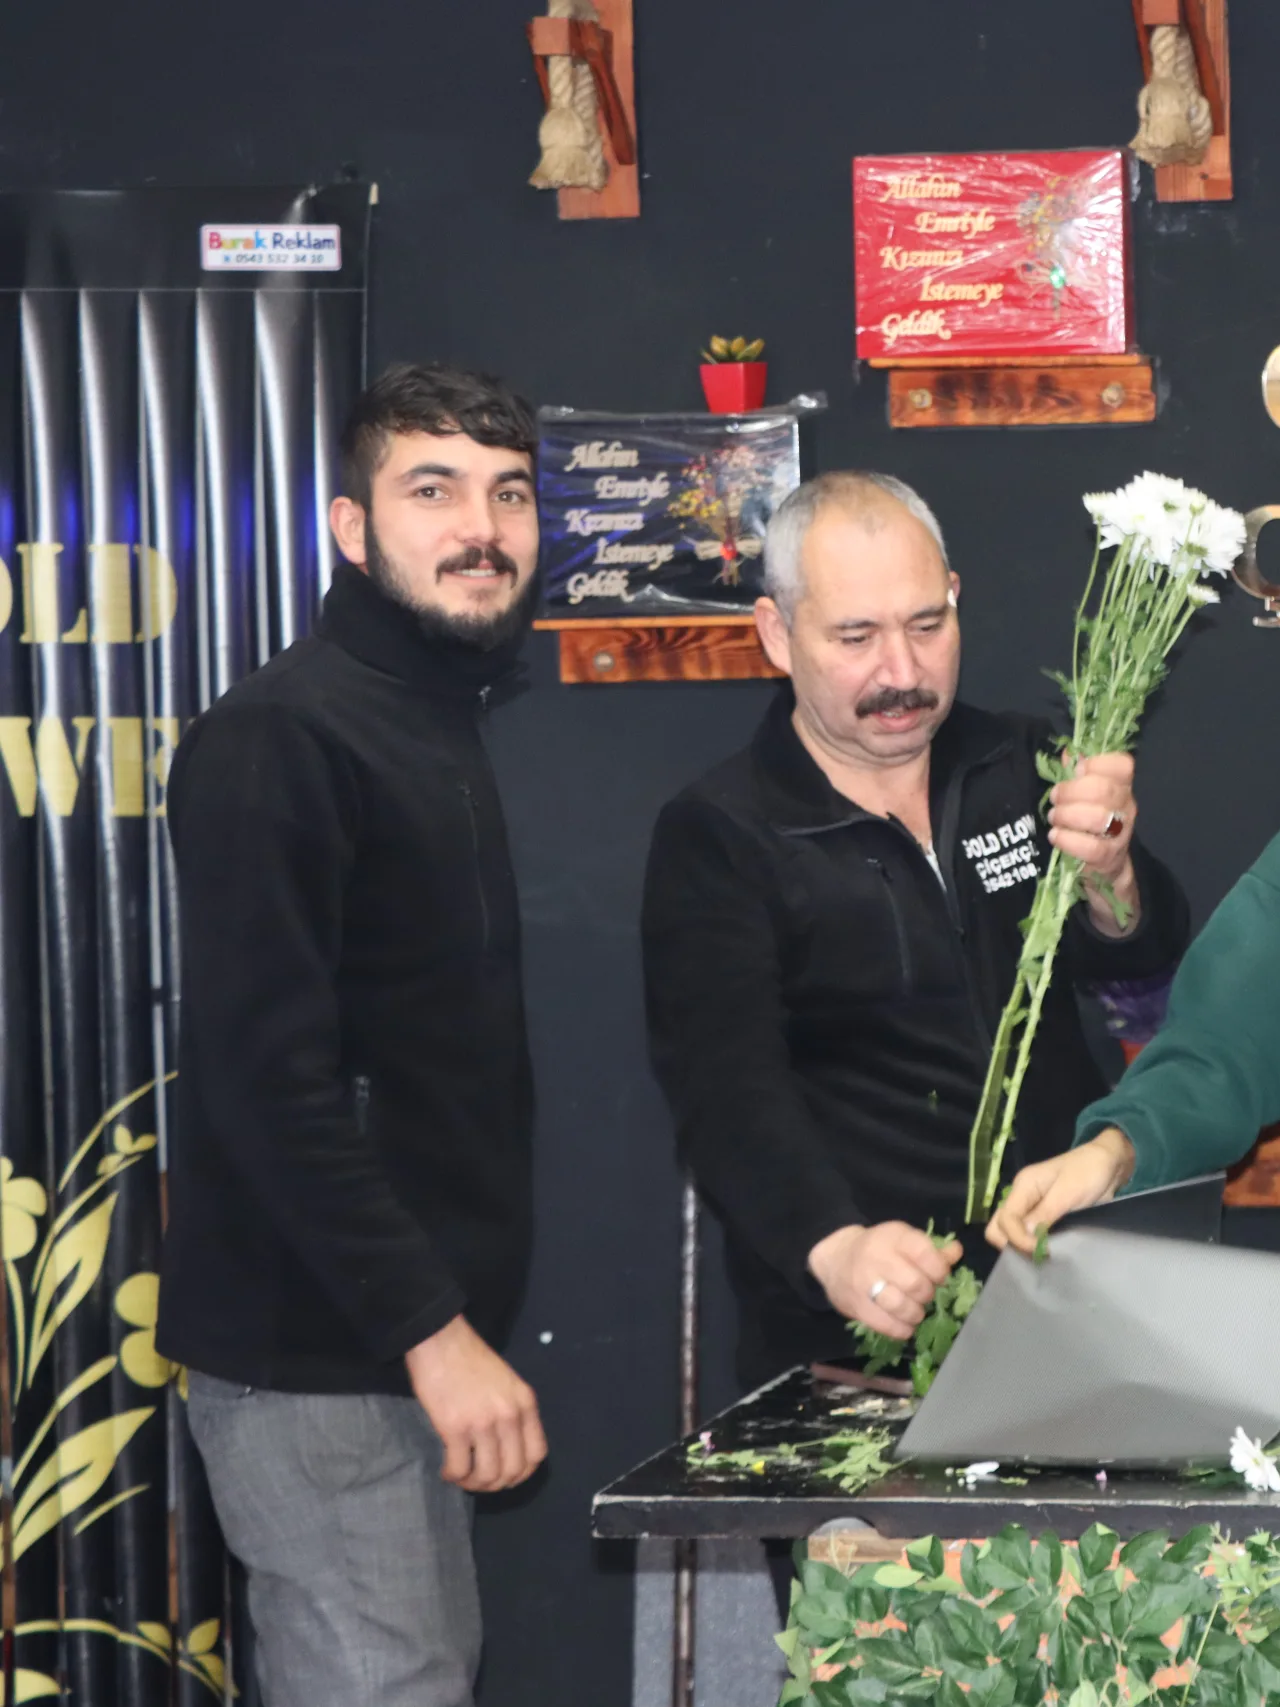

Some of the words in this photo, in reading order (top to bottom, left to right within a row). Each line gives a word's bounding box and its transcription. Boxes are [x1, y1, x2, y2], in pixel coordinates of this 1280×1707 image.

[208, 230, 267, 249] Burak
[272, 231, 336, 250] Reklam
[0, 543, 178, 643] LD
